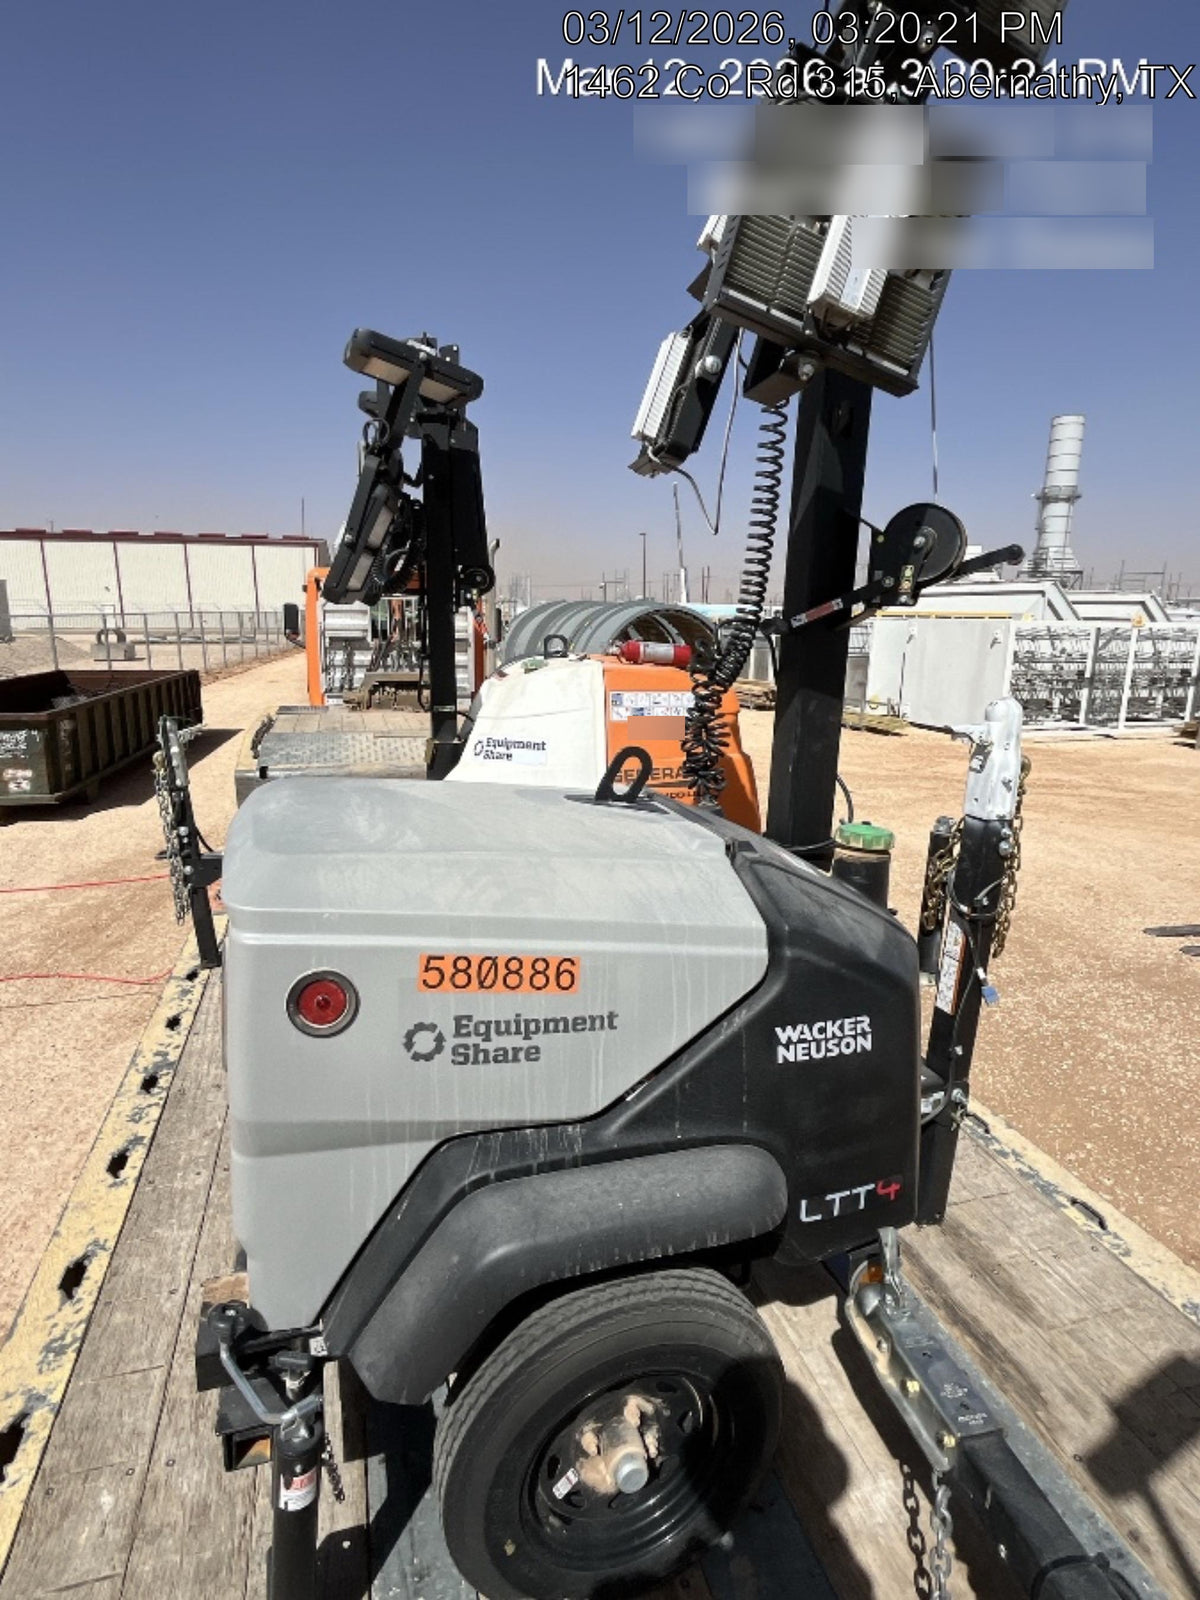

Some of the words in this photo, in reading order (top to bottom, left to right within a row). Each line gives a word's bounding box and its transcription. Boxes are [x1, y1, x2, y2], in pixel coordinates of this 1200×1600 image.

[486, 737, 546, 751] Equipment
[422, 955, 576, 991] 580886
[453, 1010, 619, 1042] Equipment
[775, 1015, 872, 1044] WACKER
[451, 1044, 541, 1066] Share
[777, 1034, 872, 1064] NEUSON
[800, 1180, 901, 1222] LTT4
